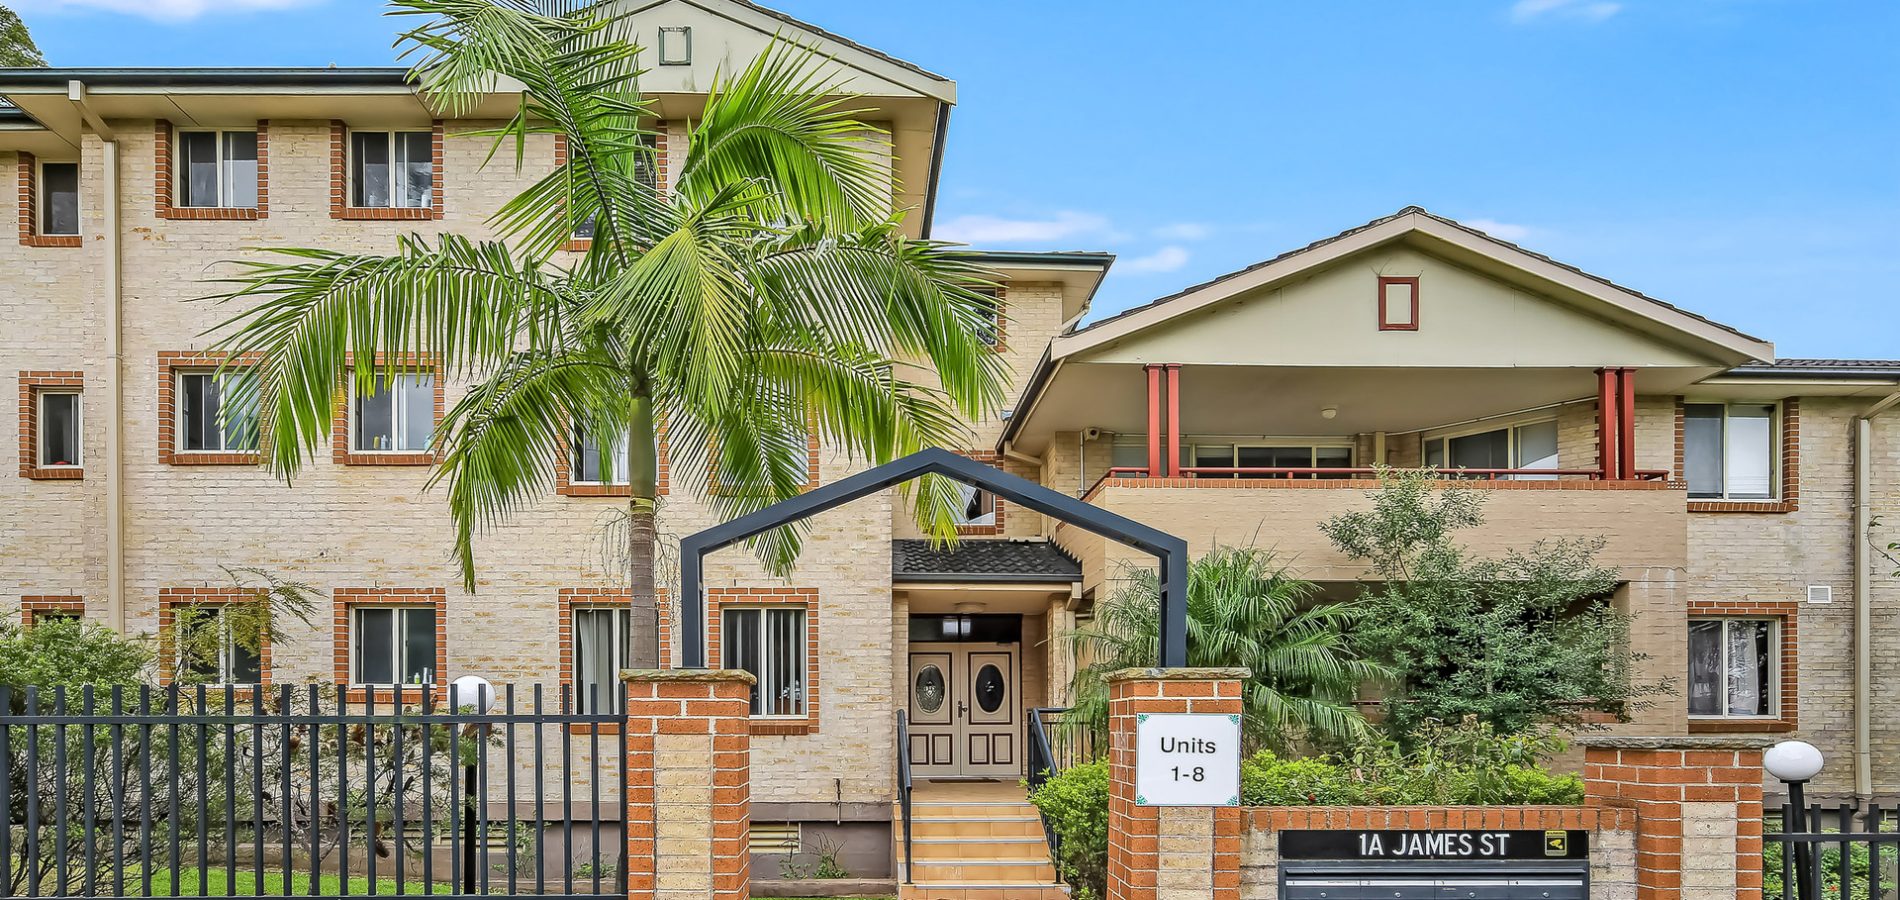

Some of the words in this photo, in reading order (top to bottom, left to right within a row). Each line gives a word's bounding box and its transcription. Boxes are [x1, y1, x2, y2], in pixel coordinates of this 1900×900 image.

[1160, 737, 1216, 754] Units
[1171, 766, 1205, 782] 1-8
[1359, 833, 1384, 855] 1A
[1392, 833, 1473, 855] JAMES
[1479, 833, 1510, 855] ST
